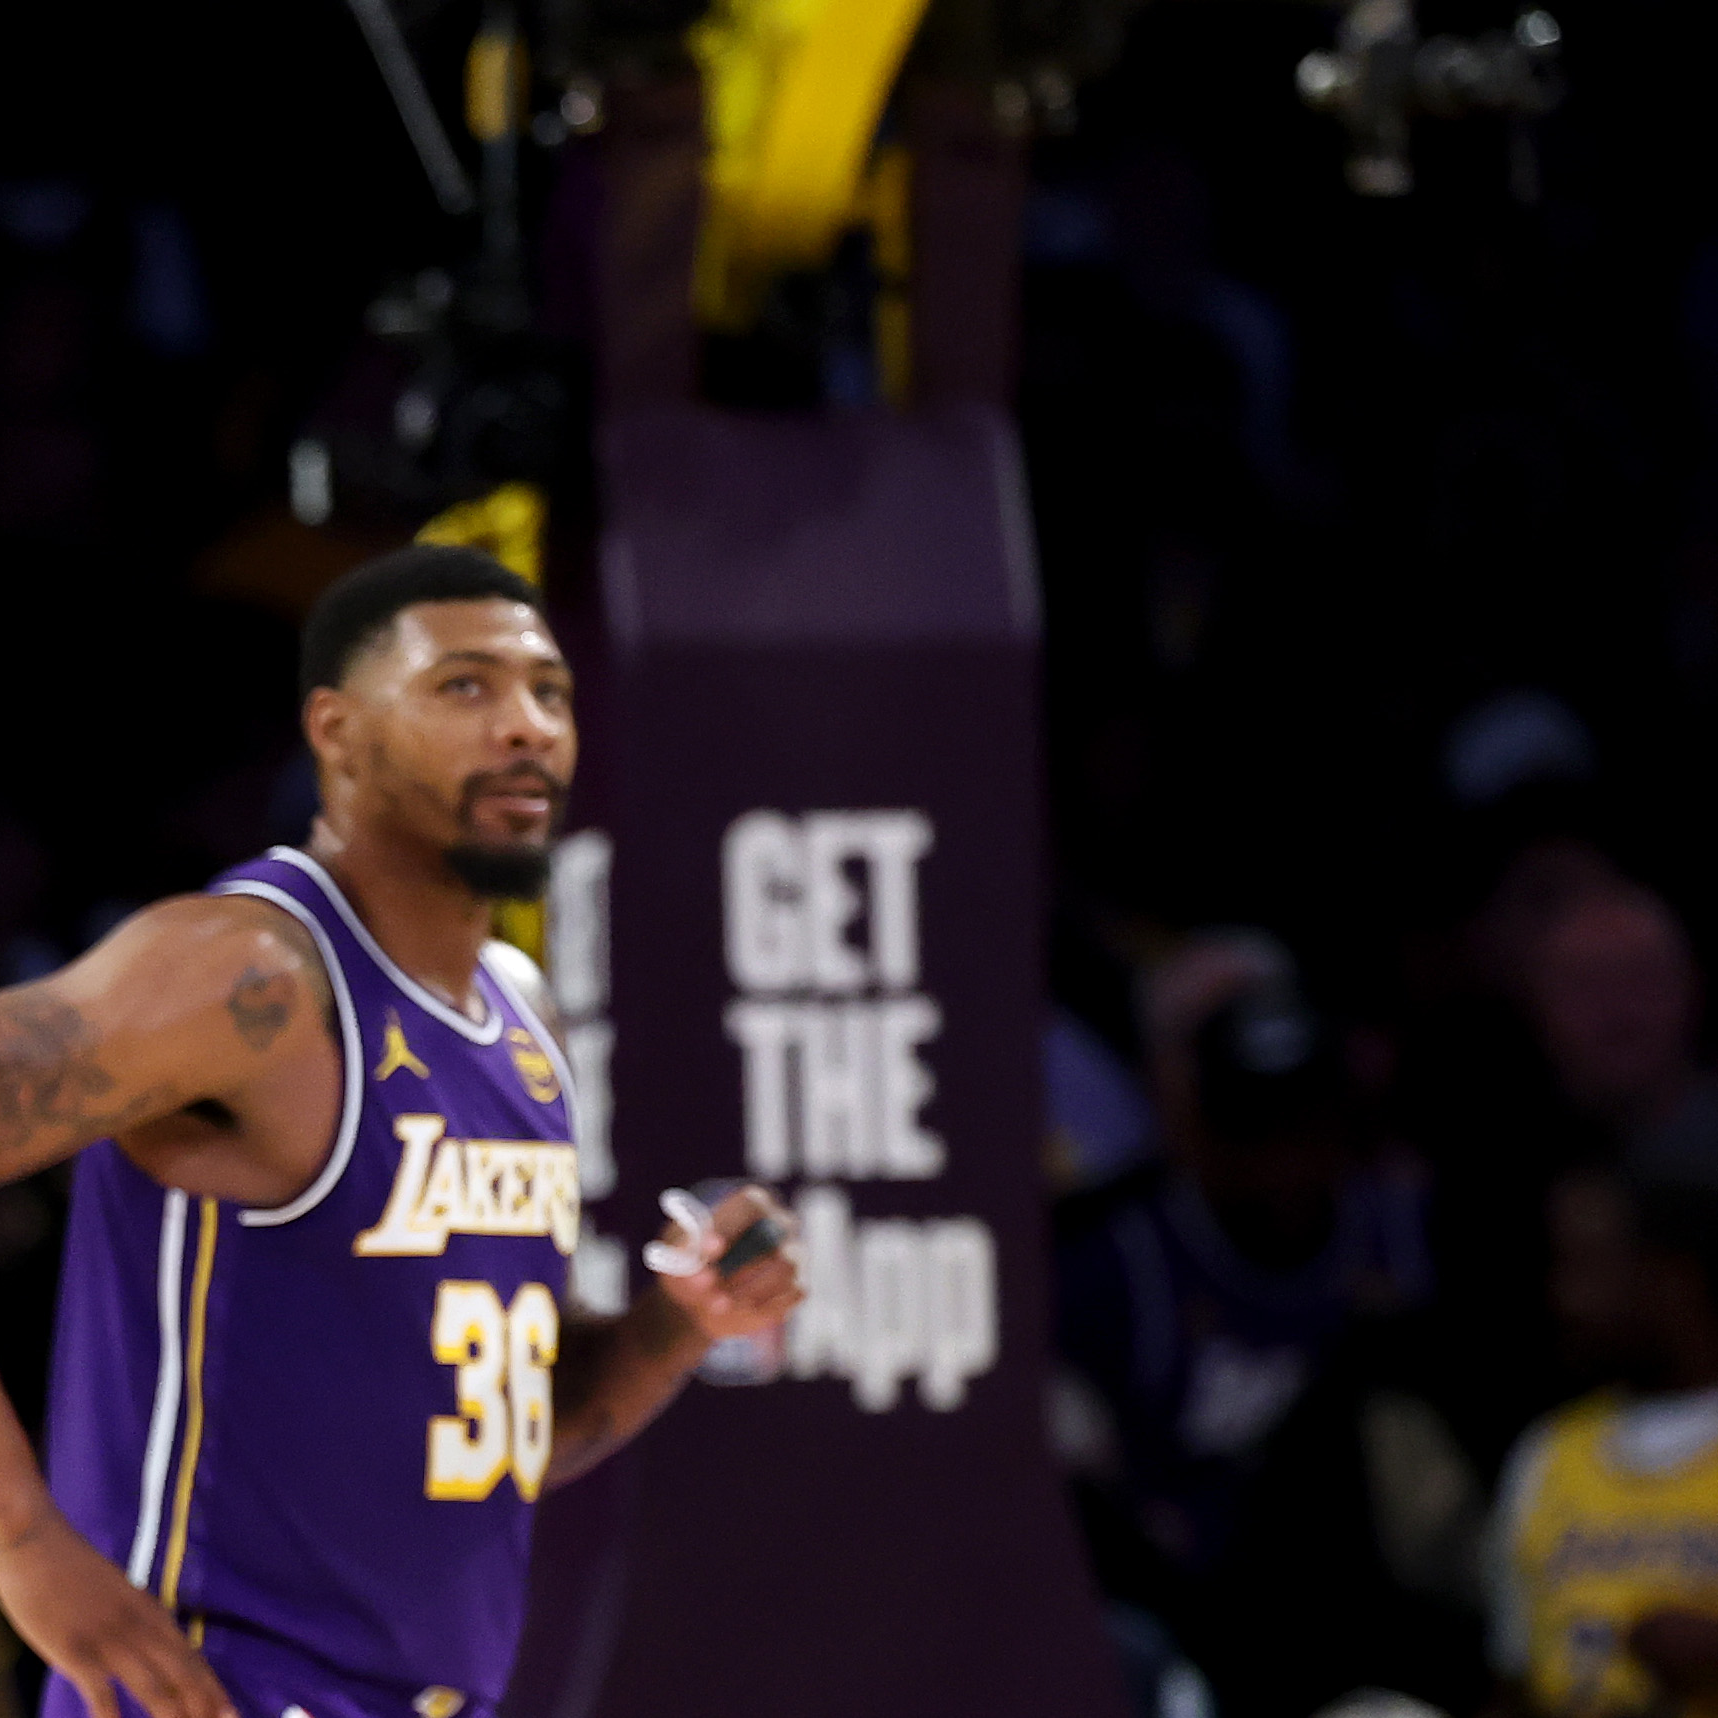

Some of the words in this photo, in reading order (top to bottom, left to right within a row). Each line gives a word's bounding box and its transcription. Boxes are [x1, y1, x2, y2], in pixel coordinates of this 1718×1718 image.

[720, 807, 935, 991] GET
[721, 996, 948, 1182] THE
[423, 1278, 561, 1502] 36
